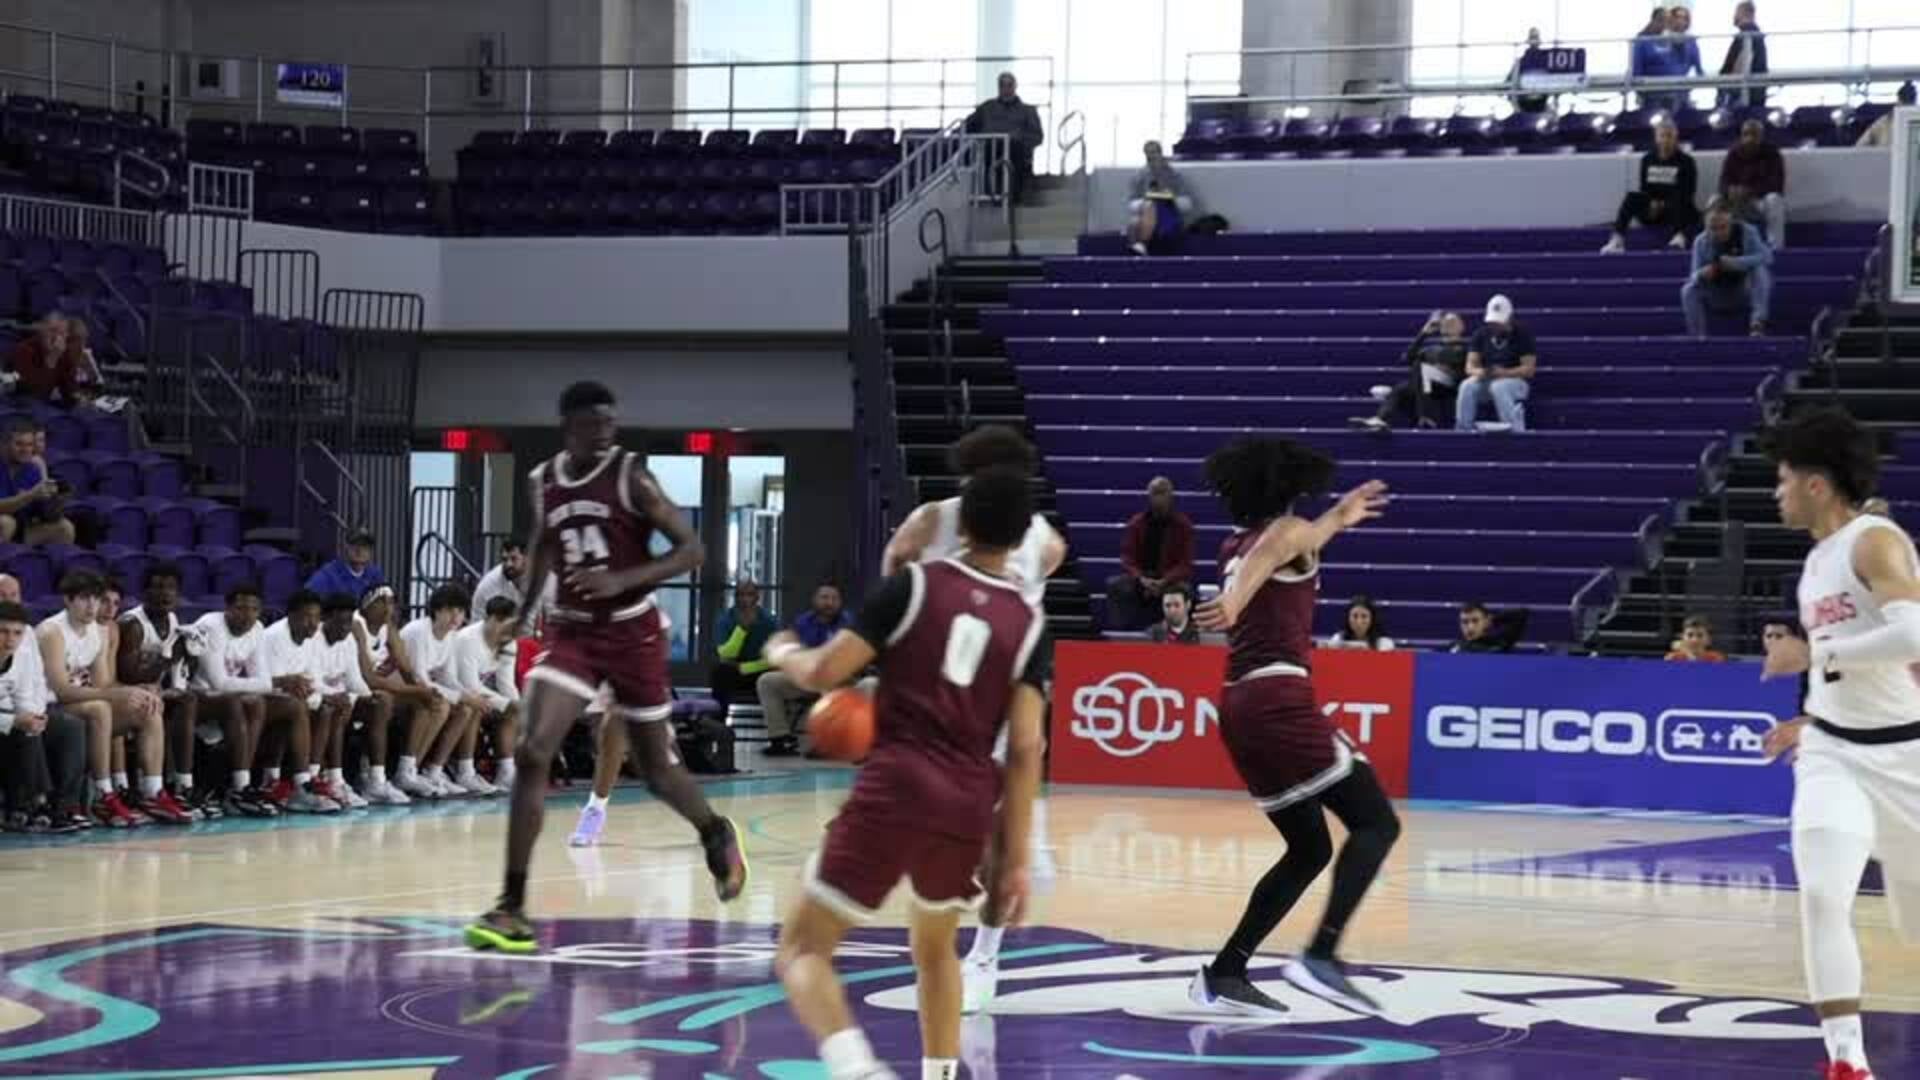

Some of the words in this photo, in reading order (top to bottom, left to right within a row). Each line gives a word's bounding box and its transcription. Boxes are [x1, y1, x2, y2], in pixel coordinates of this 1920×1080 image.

[302, 70, 331, 88] 120
[1547, 51, 1576, 69] 101
[560, 525, 609, 563] 34
[941, 612, 992, 686] 0
[1194, 696, 1391, 744] NT
[1426, 705, 1647, 756] GEICO
